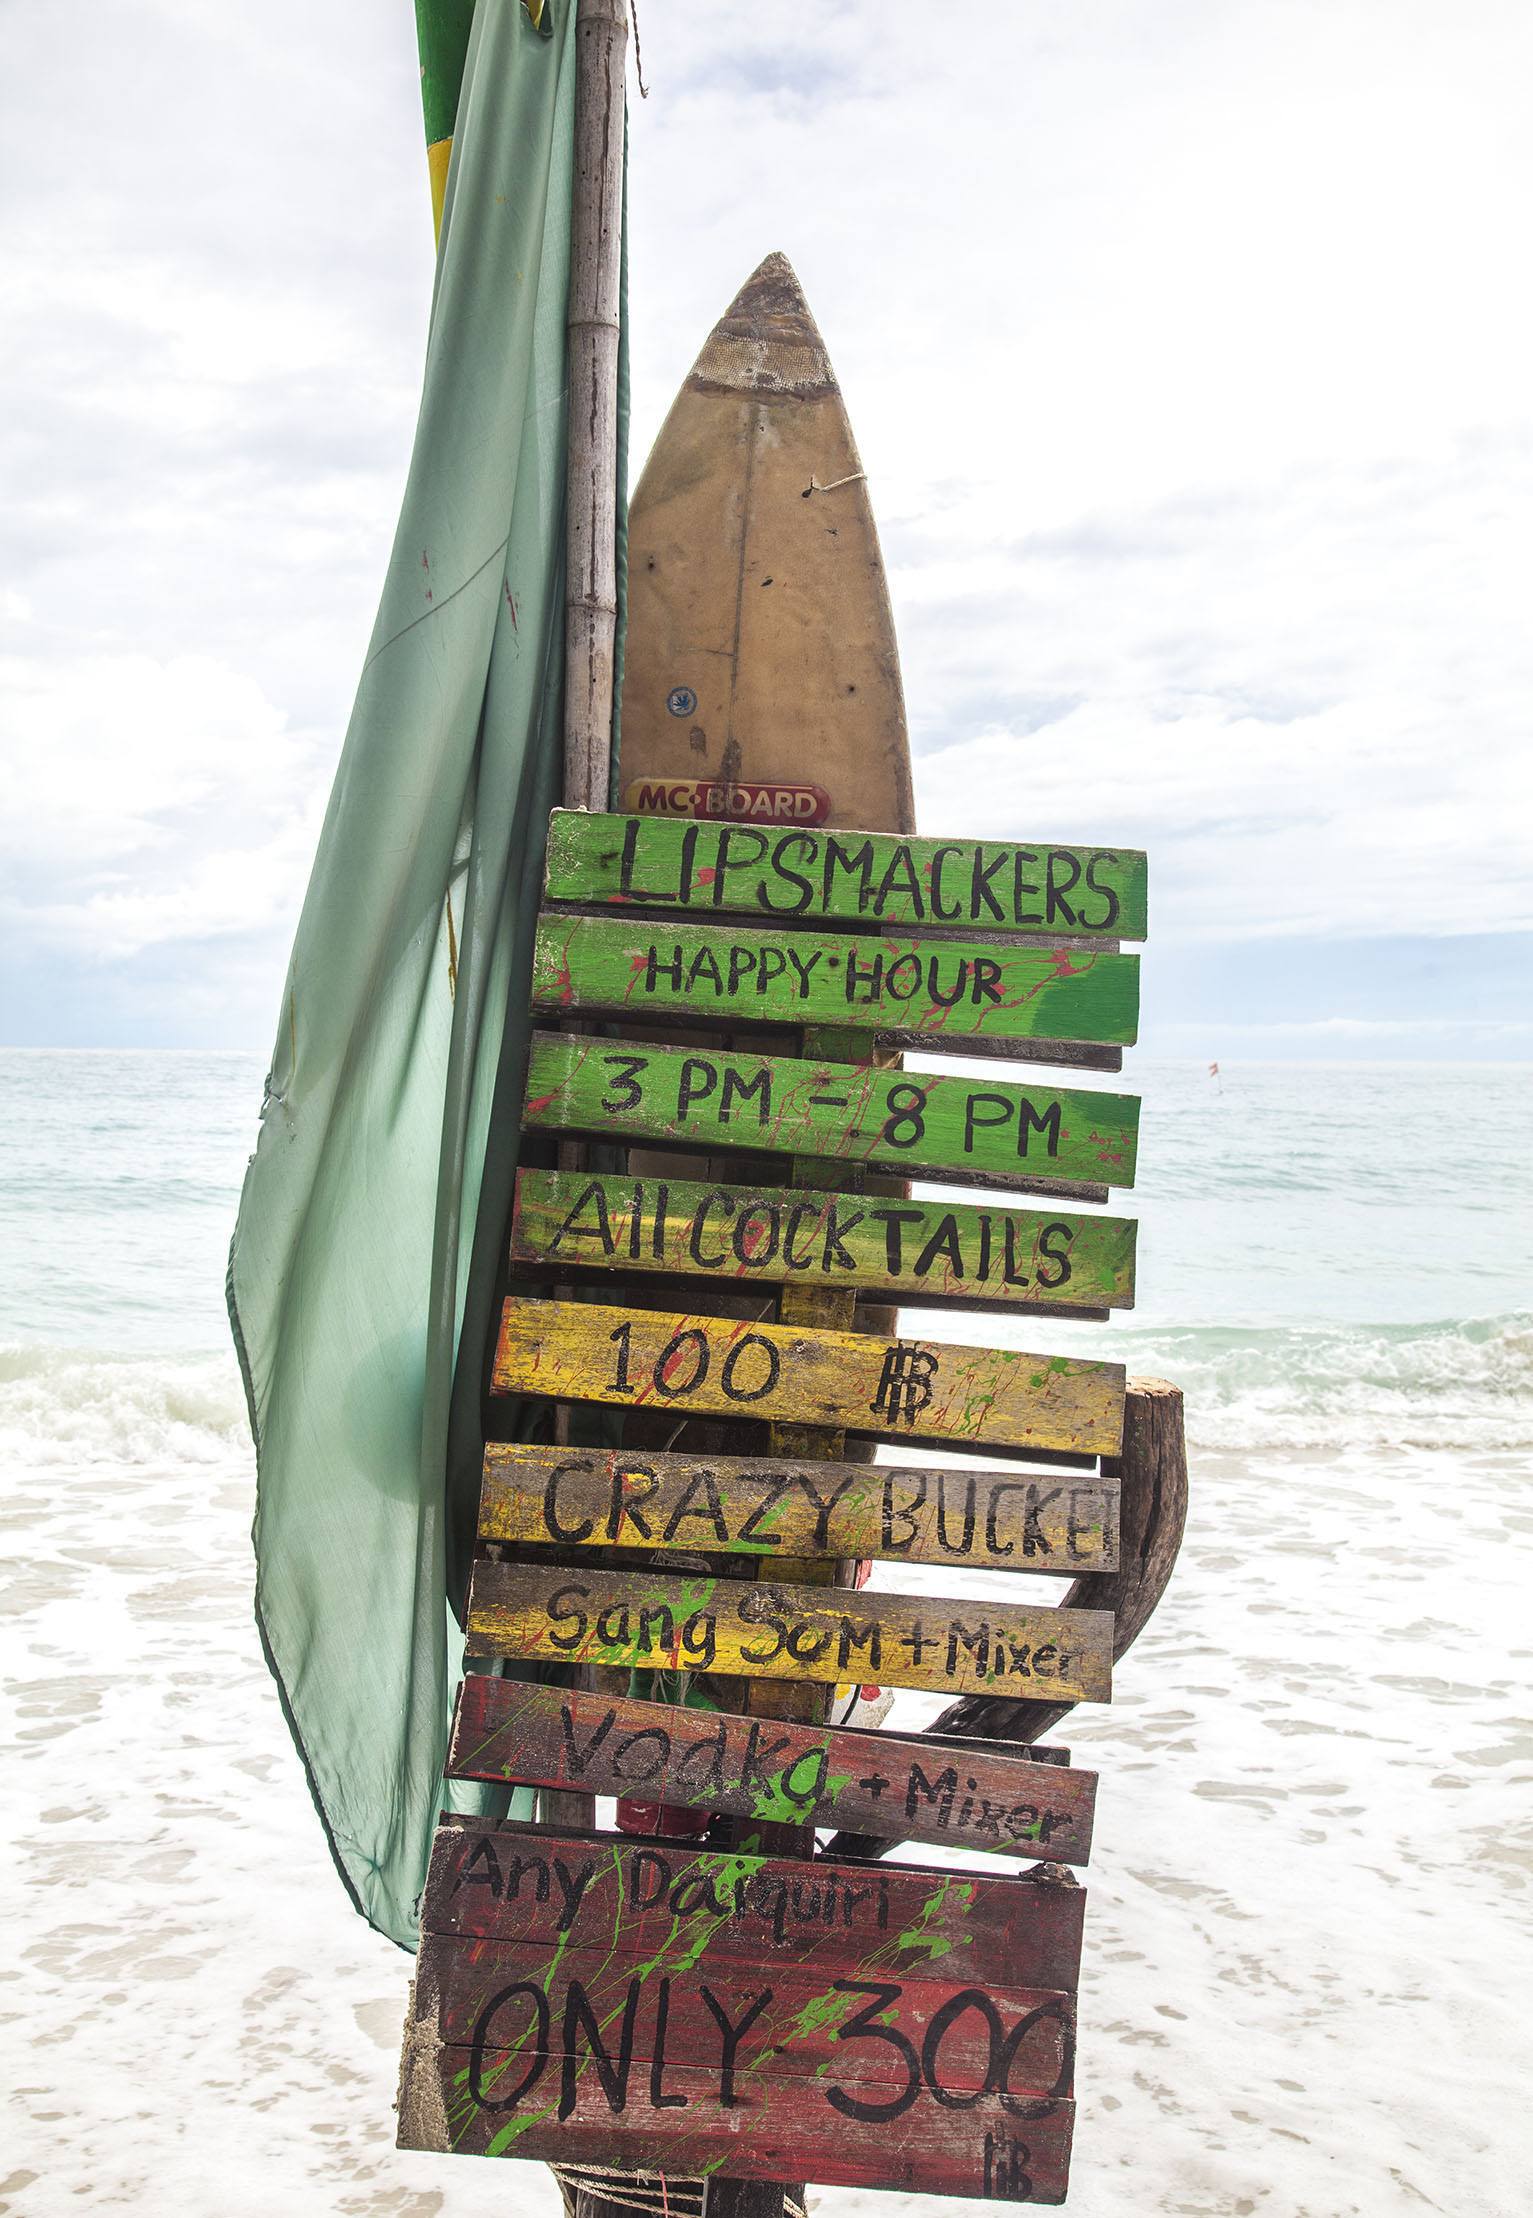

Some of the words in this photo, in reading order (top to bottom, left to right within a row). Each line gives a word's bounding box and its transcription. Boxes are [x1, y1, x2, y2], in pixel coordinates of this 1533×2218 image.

[621, 820, 1119, 929] LIPSMACKERS
[646, 945, 822, 998] HAPPY
[847, 949, 1001, 1007] HOUR
[601, 1056, 648, 1113] 3
[677, 1058, 770, 1126] PM
[884, 1084, 925, 1148] 8
[965, 1094, 1061, 1157] PM
[689, 1191, 1072, 1288] COCKTAILS
[605, 1321, 780, 1401] 100
[545, 1460, 853, 1548] CRAZY
[547, 1585, 717, 1669] Sang
[946, 1617, 1074, 1680] Mixer
[561, 1706, 829, 1802] Vodka
[860, 1772, 889, 1800] +
[905, 1762, 1073, 1843] Mixer
[453, 1838, 594, 1932] Any
[469, 1978, 773, 2121] ONLY
[824, 1979, 1075, 2122] 300
